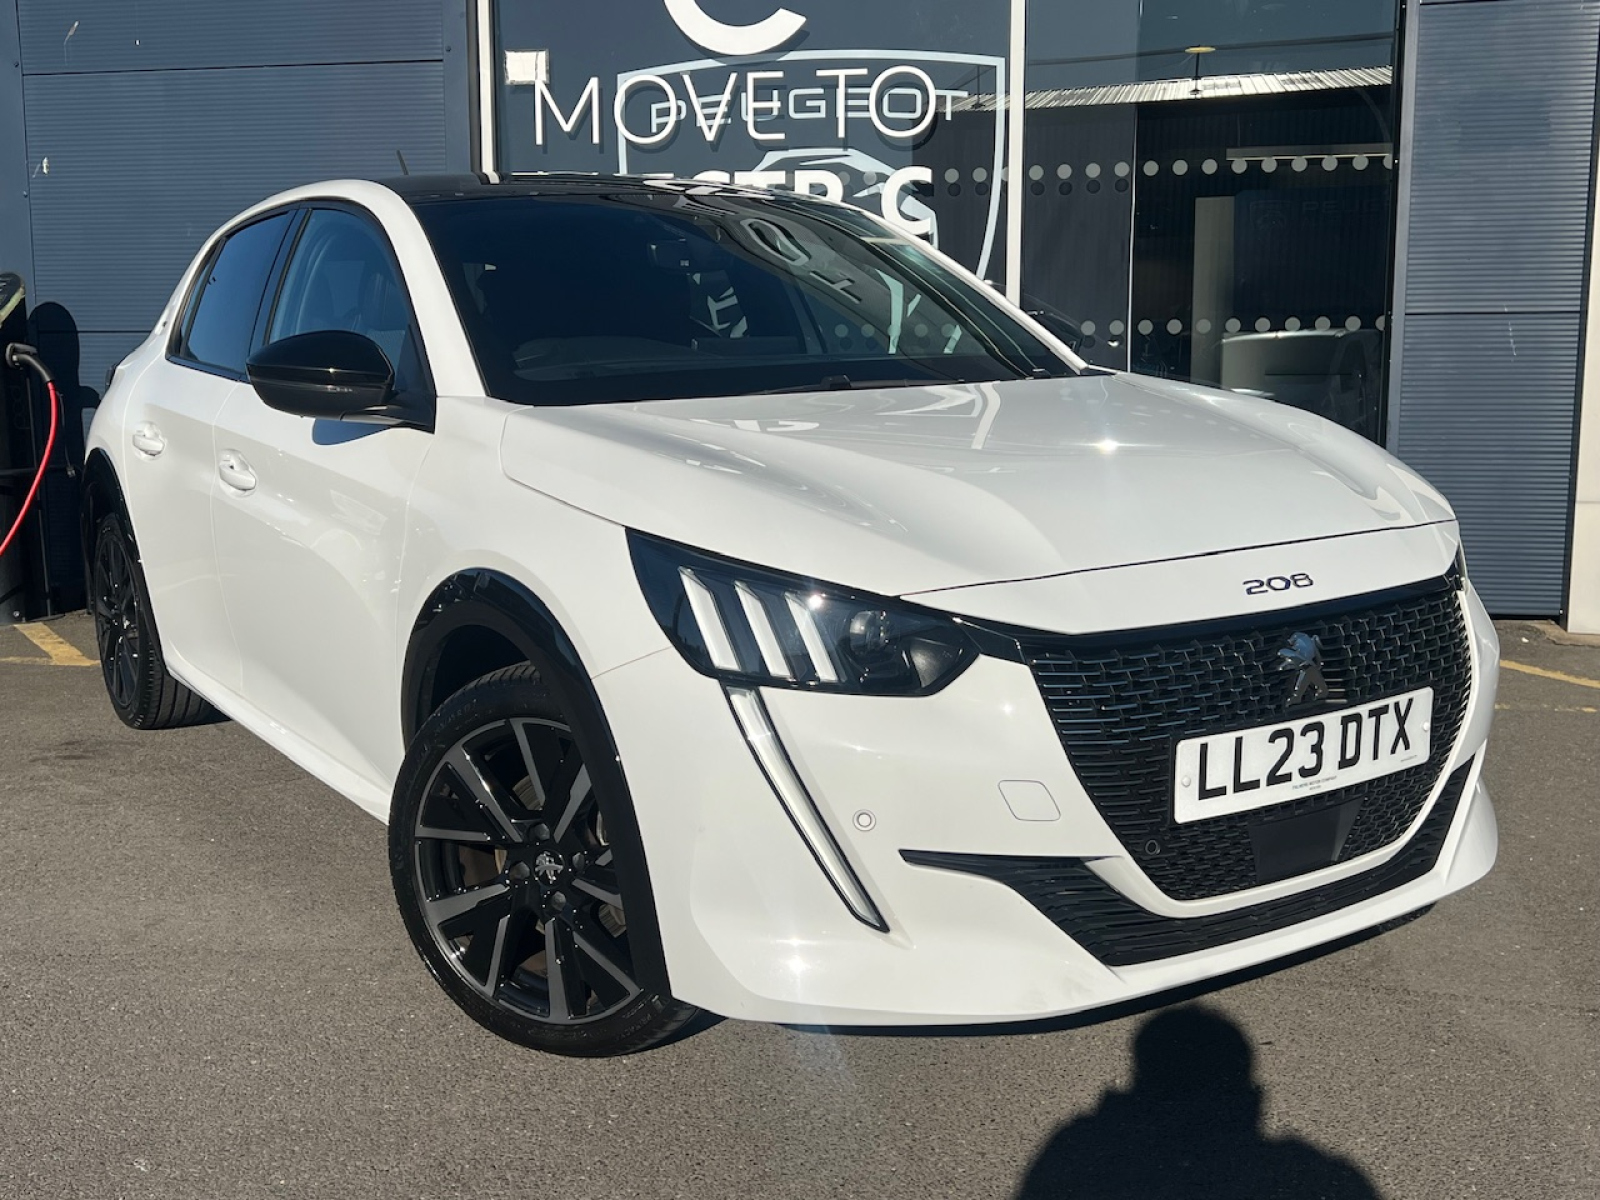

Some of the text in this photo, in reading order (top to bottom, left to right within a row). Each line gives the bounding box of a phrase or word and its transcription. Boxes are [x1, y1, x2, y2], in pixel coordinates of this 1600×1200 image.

[534, 66, 937, 145] MOVE TO
[650, 88, 968, 133] PEUGEOT
[1243, 573, 1314, 595] 208
[1199, 697, 1414, 800] LL23 DTX
